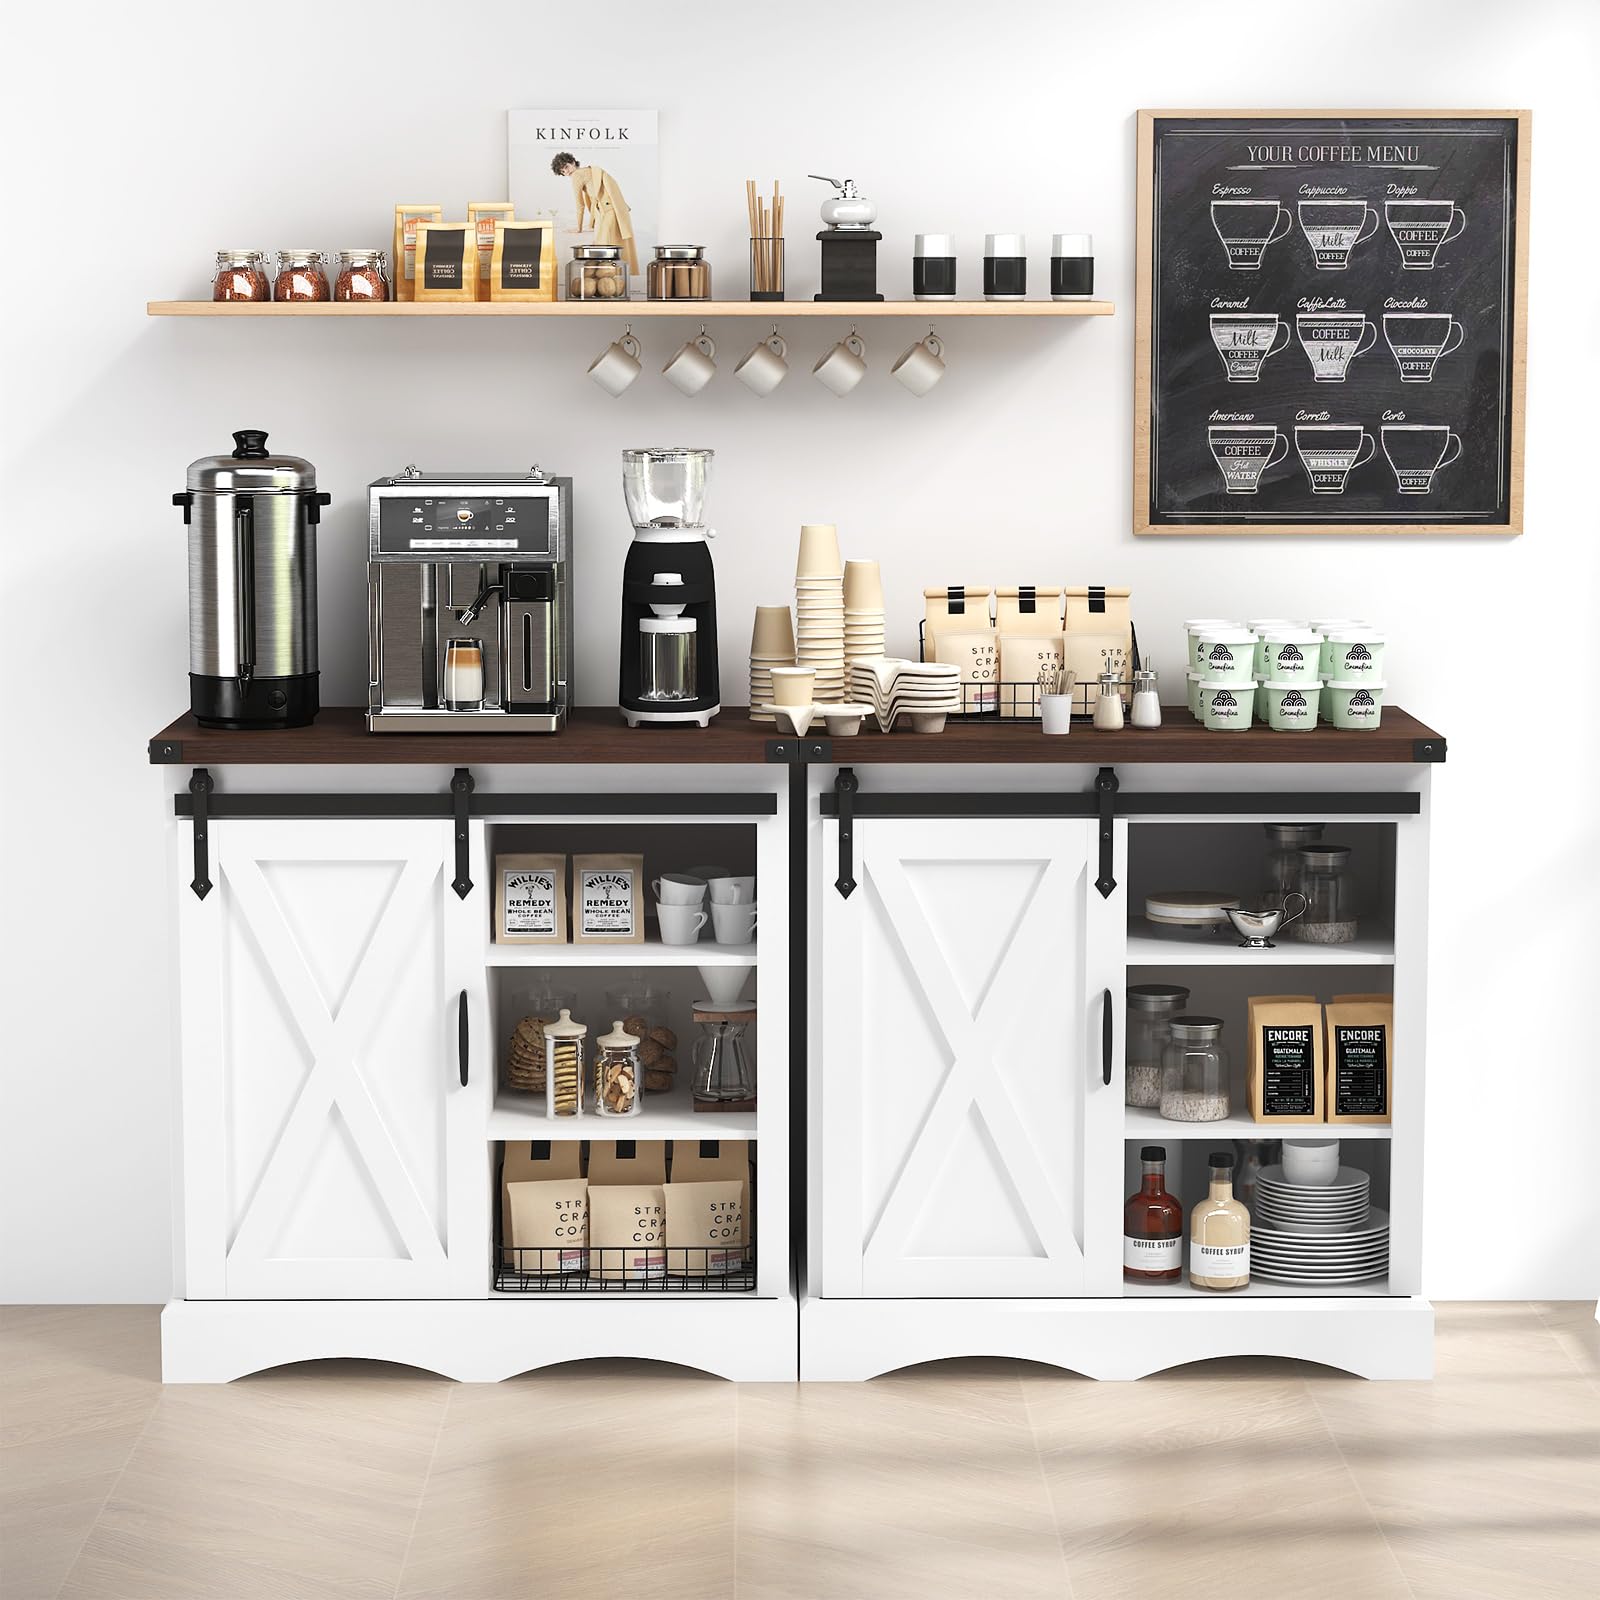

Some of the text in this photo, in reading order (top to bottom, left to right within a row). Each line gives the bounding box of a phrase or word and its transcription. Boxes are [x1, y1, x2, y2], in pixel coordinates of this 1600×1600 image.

[536, 128, 629, 140] KINFOLK
[1247, 145, 1420, 162] YOUR COFFEE MENU
[1211, 183, 1252, 197] Espresso
[1298, 183, 1348, 197] Cappuccino
[1386, 183, 1418, 197] Doppio
[1320, 233, 1345, 249] Milk
[1399, 229, 1439, 242] COFFEE
[1230, 247, 1261, 257] COFFEE
[1318, 251, 1345, 260] COFFEE
[1406, 249, 1431, 258] COFFEE
[1210, 297, 1249, 310] Caramel
[1383, 297, 1428, 310] Cioccolato
[1231, 330, 1259, 348] Milk
[1312, 328, 1350, 340] COFFEE
[1228, 350, 1259, 359] COFFEE
[1316, 346, 1345, 363] Milk
[1397, 347, 1437, 355] CHOCOLATE
[1401, 361, 1431, 371] COFFEE
[1208, 410, 1254, 422] Americano
[1294, 410, 1330, 422] Corretto
[1382, 410, 1406, 422] Corto
[1224, 445, 1262, 456] COFFEE
[1309, 458, 1350, 468] WHISKEY
[1226, 471, 1257, 480] WATER
[1314, 473, 1343, 483] COFFEE
[1401, 477, 1428, 486] COFFEE
[1101, 649, 1127, 657] STR
[1104, 659, 1127, 667] RA
[507, 874, 553, 891] WILLIE'S
[585, 874, 630, 891] WILLIE'S
[508, 899, 552, 907] REMEDY
[586, 899, 629, 907] REMEDY
[1268, 1030, 1309, 1041] ENCORE
[1340, 1030, 1381, 1041] ENCORE
[555, 1200, 588, 1210] STR
[634, 1206, 666, 1215] STR
[1133, 1240, 1176, 1249] COFFEE SYRUP
[1201, 1247, 1245, 1256] COFFEE SYRUP
